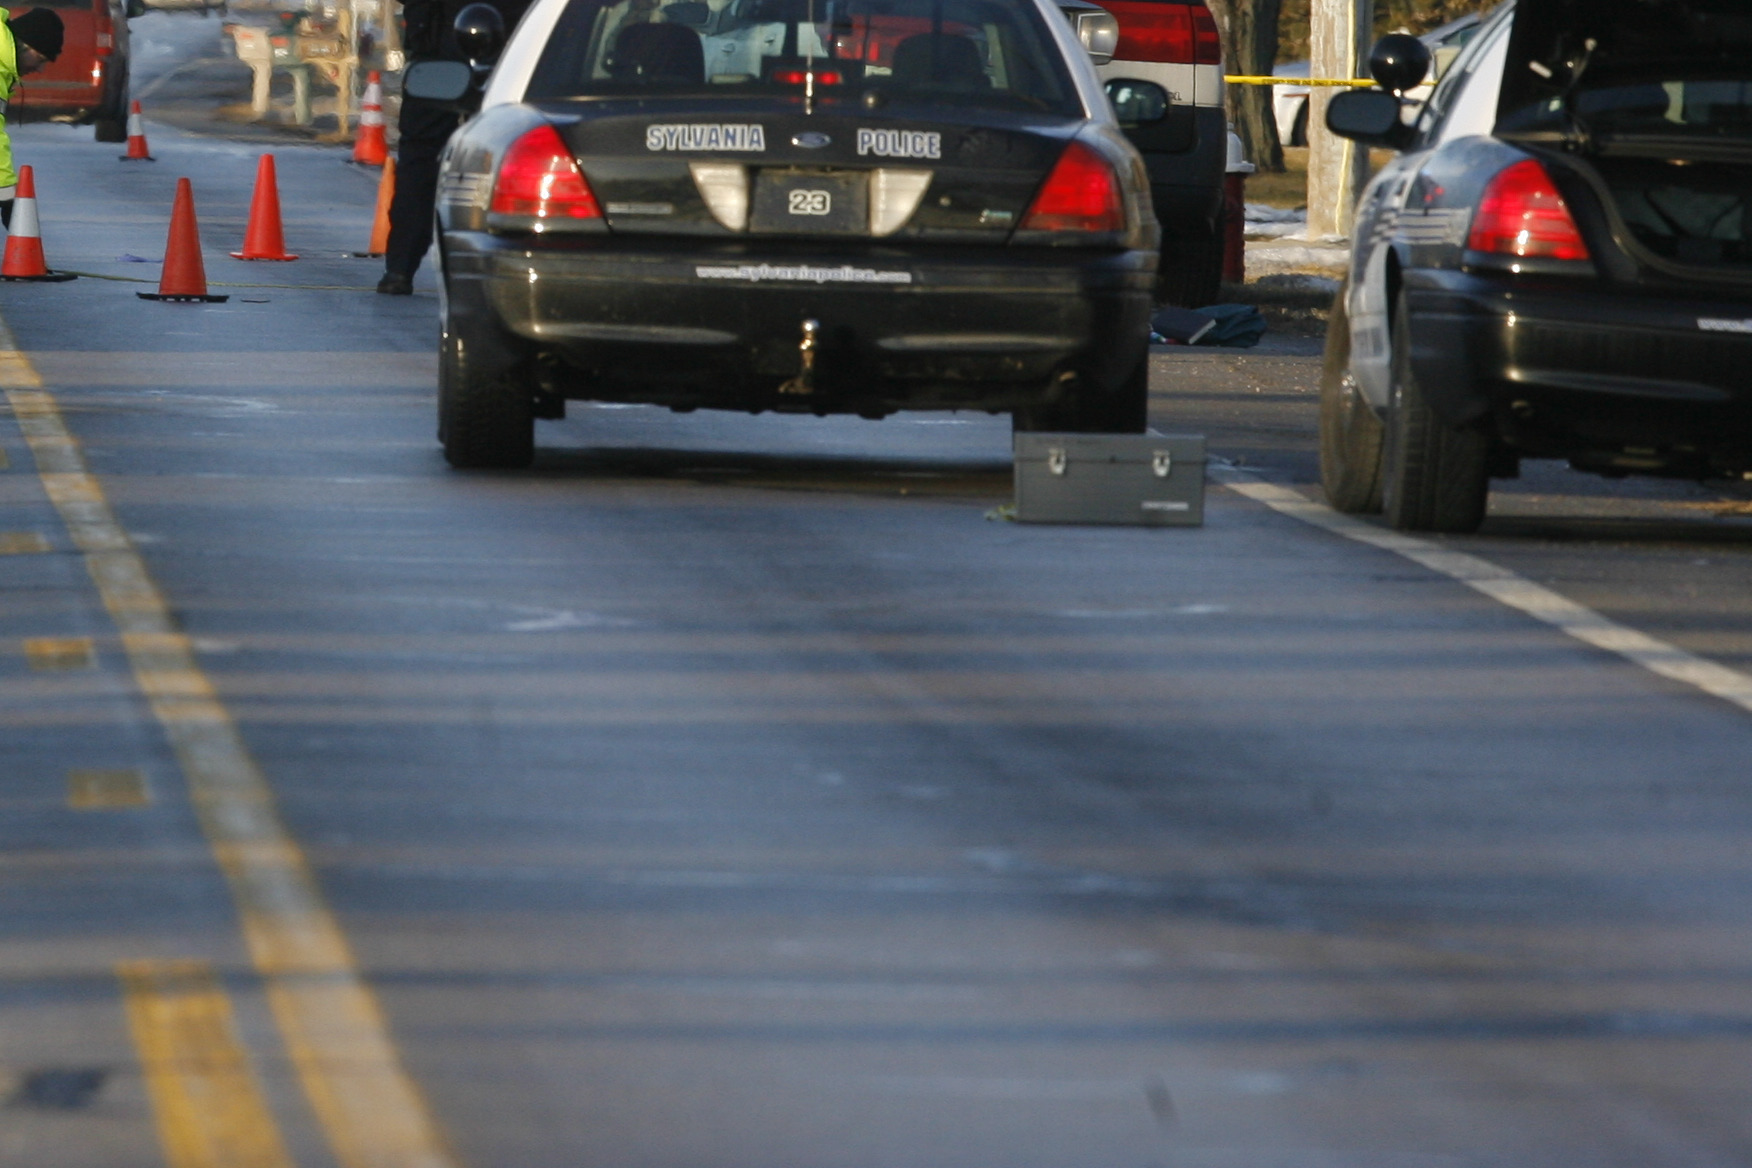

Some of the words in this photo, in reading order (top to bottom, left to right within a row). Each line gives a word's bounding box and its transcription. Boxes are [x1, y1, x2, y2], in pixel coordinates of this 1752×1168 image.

[646, 123, 766, 151] SYLVANIA
[857, 127, 942, 159] POLICE
[788, 189, 831, 215] 23
